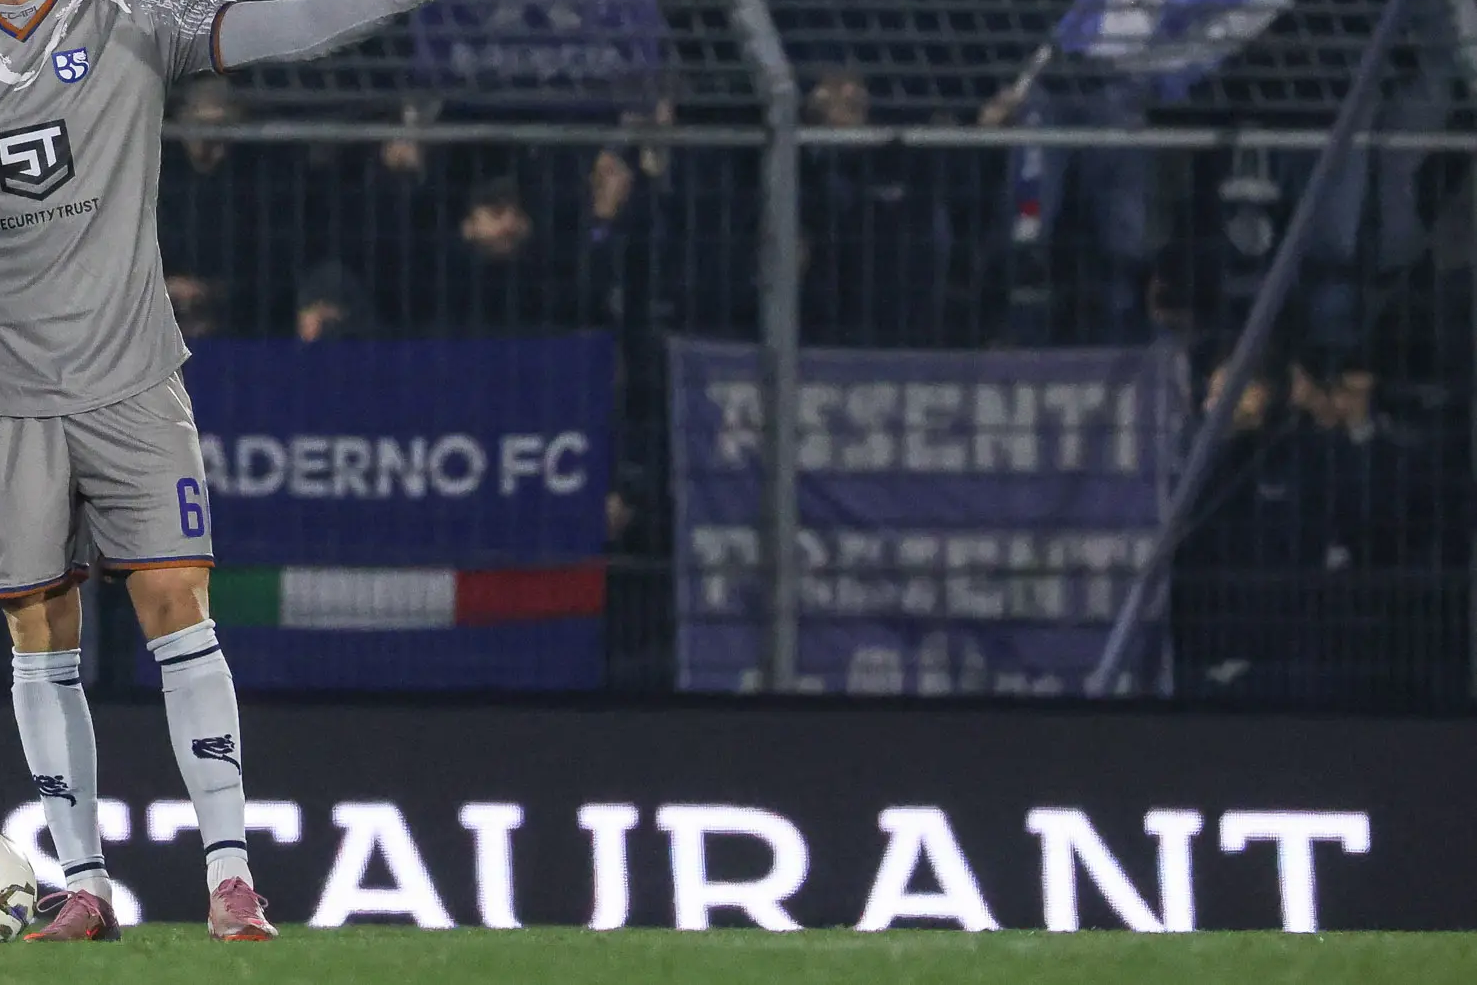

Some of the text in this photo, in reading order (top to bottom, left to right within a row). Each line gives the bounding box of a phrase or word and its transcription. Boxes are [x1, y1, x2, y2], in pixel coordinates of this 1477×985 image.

[57, 197, 100, 218] TRUST
[498, 430, 591, 496] FC
[176, 477, 211, 538] 6
